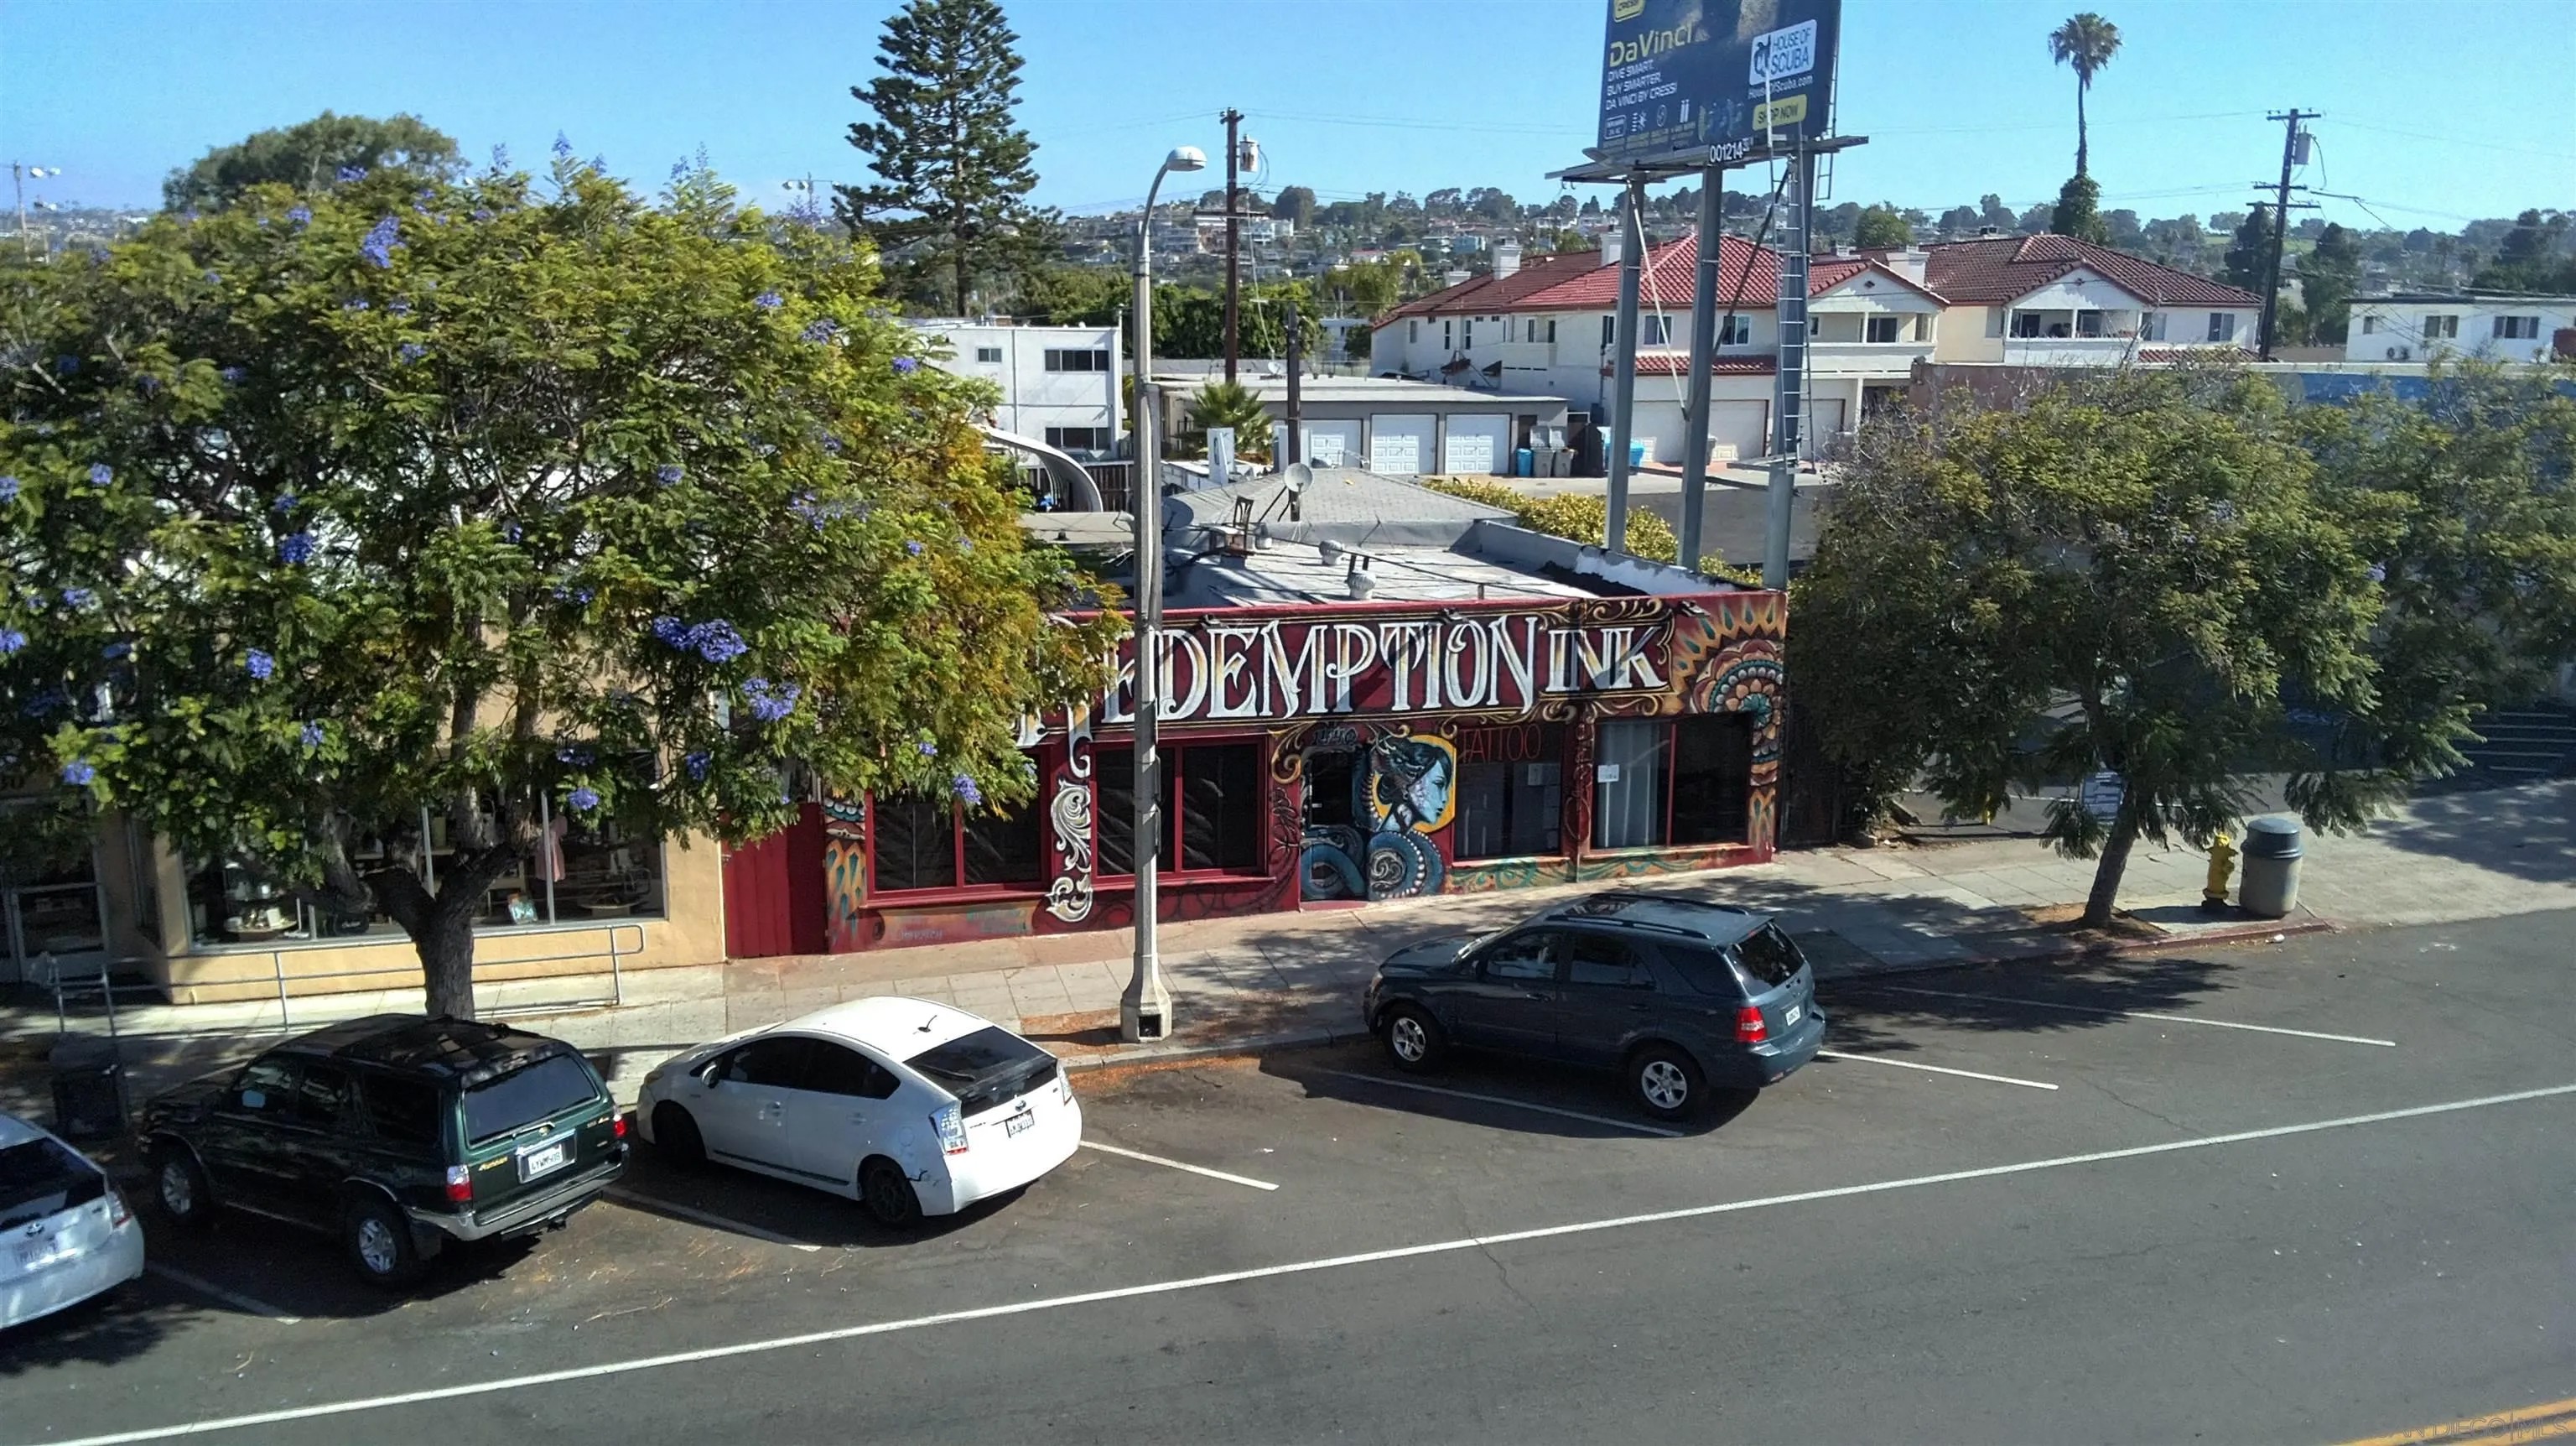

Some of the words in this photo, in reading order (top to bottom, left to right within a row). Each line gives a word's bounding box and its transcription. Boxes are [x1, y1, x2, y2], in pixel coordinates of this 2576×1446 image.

[1773, 29, 1800, 51] HOUSE
[1800, 27, 1811, 44] OF
[1770, 46, 1810, 75] SCUBA
[1779, 103, 1800, 120] NOW
[1545, 625, 1669, 692] INK
[1457, 722, 1541, 764] TATTOO
